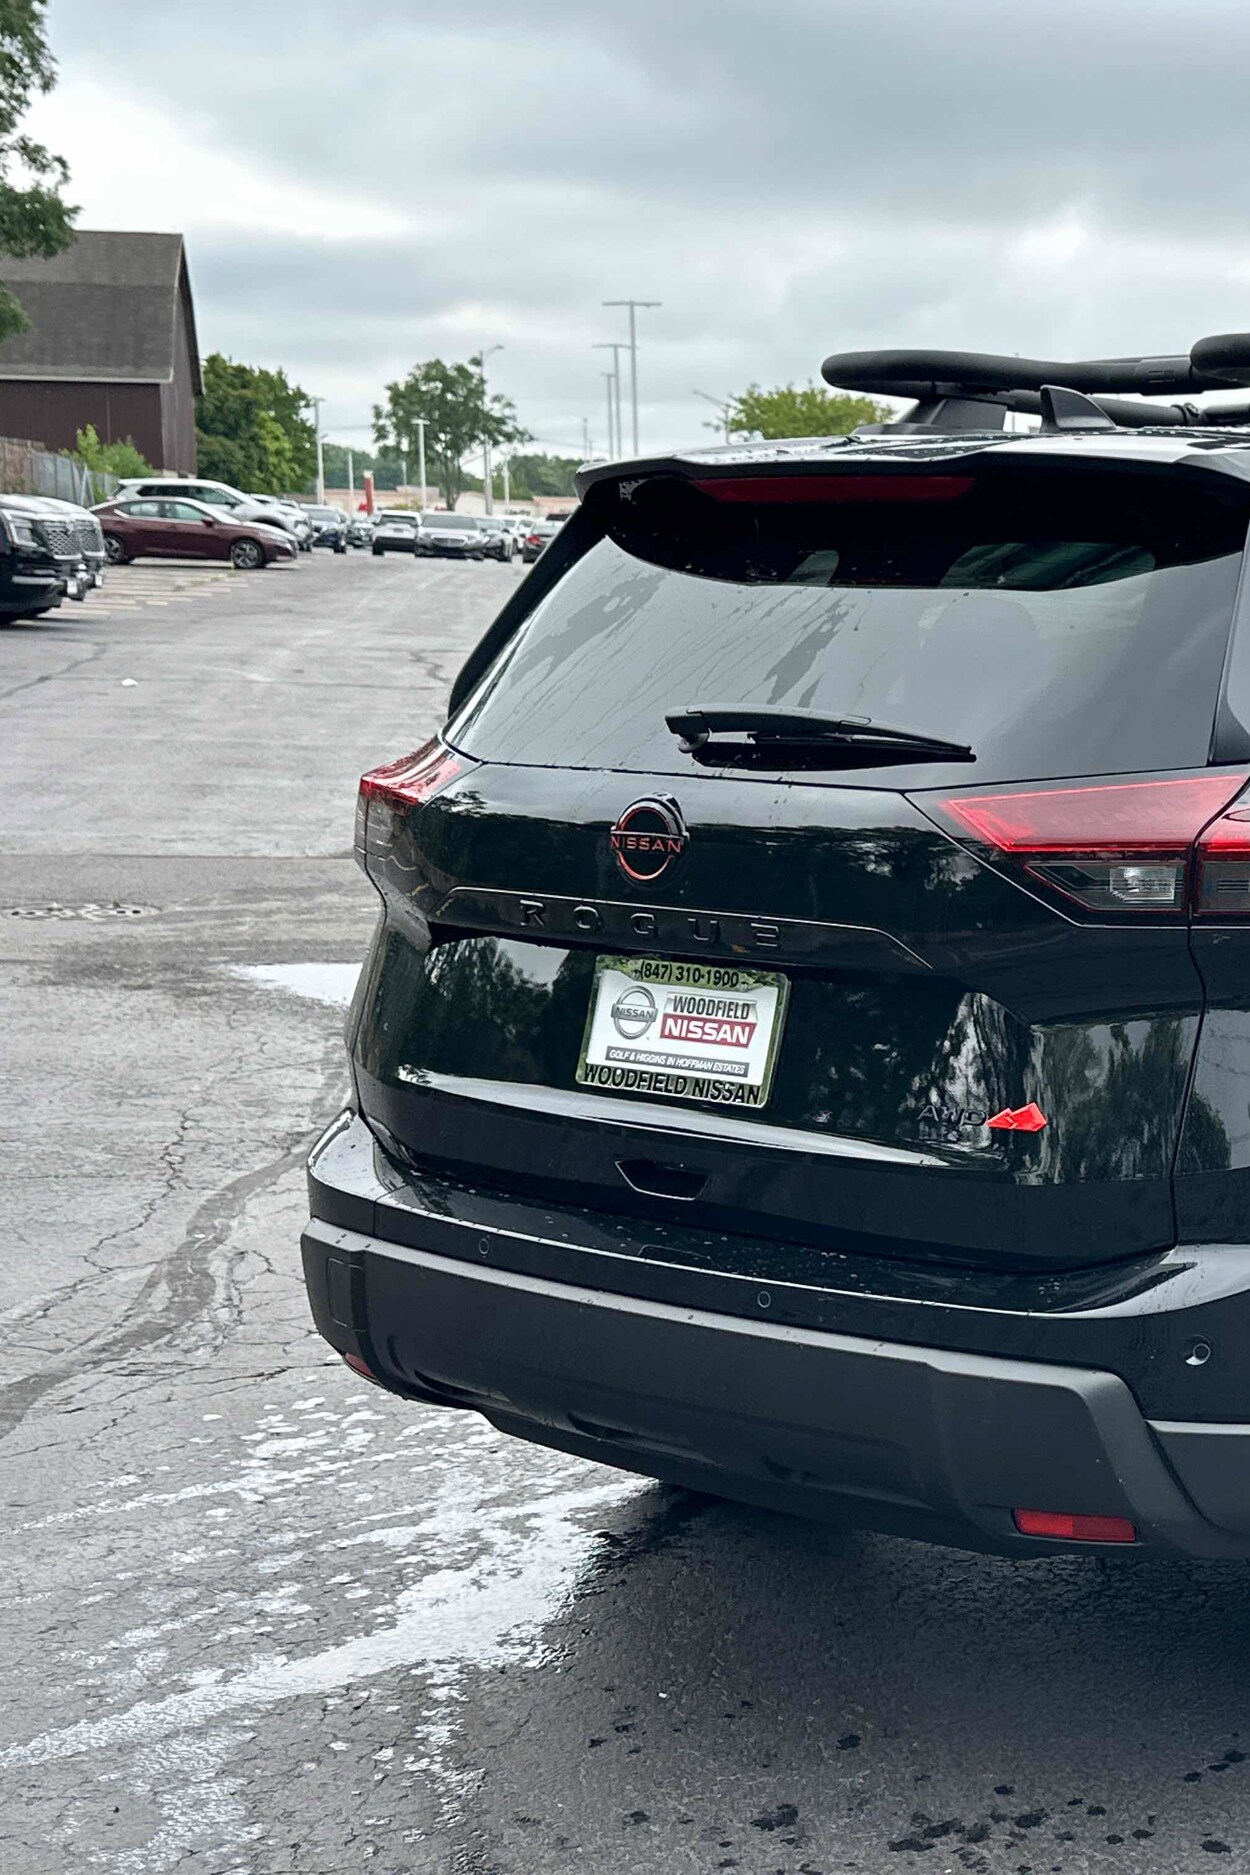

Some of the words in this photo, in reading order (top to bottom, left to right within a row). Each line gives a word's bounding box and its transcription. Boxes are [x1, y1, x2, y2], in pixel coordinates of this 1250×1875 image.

[610, 835, 681, 853] NISSAN
[519, 899, 779, 949] ROGUE
[640, 960, 673, 980] (847)
[615, 1006, 654, 1018] NISSAN
[673, 995, 750, 1020] WOODFIELD
[664, 1018, 749, 1045] NISSAN
[609, 1049, 630, 1060] GOLF
[676, 1057, 712, 1070] HOFFMAN
[713, 1062, 746, 1074] ESTATES
[584, 1065, 687, 1095] WOODFIELD
[692, 1080, 760, 1105] NISSAN
[918, 1105, 987, 1127] AWD
